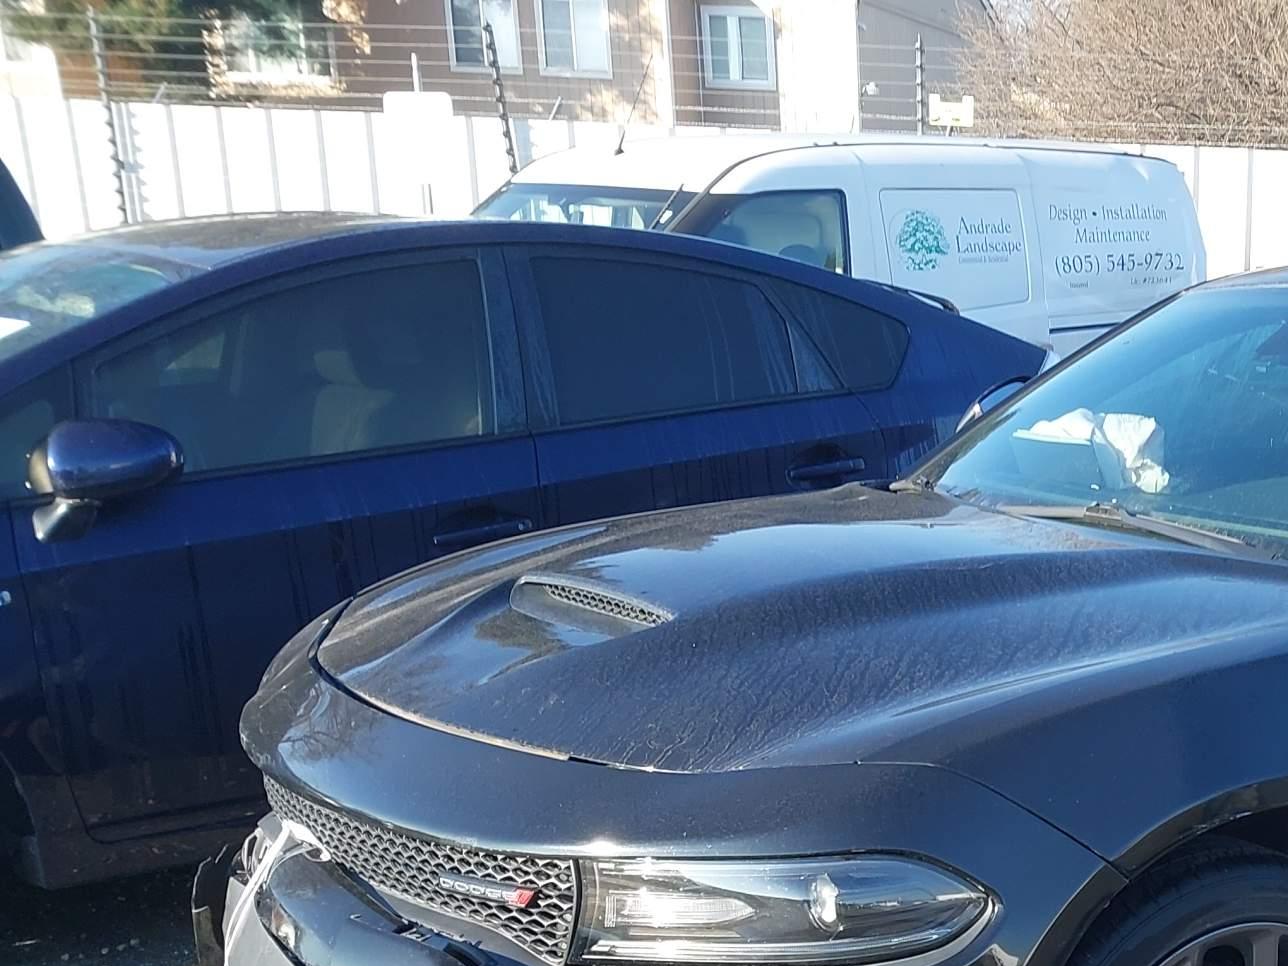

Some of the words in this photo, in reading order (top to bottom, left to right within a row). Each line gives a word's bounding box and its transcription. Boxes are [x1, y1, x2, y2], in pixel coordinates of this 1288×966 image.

[958, 215, 1012, 235] Andrade
[1048, 203, 1088, 226] Design
[1101, 202, 1168, 221] Installation
[956, 234, 1022, 256] Landscape
[1074, 226, 1152, 244] Maintenance
[1055, 254, 1100, 277] (805)
[1106, 251, 1185, 273] 545-9732
[438, 876, 518, 904] DODGE
